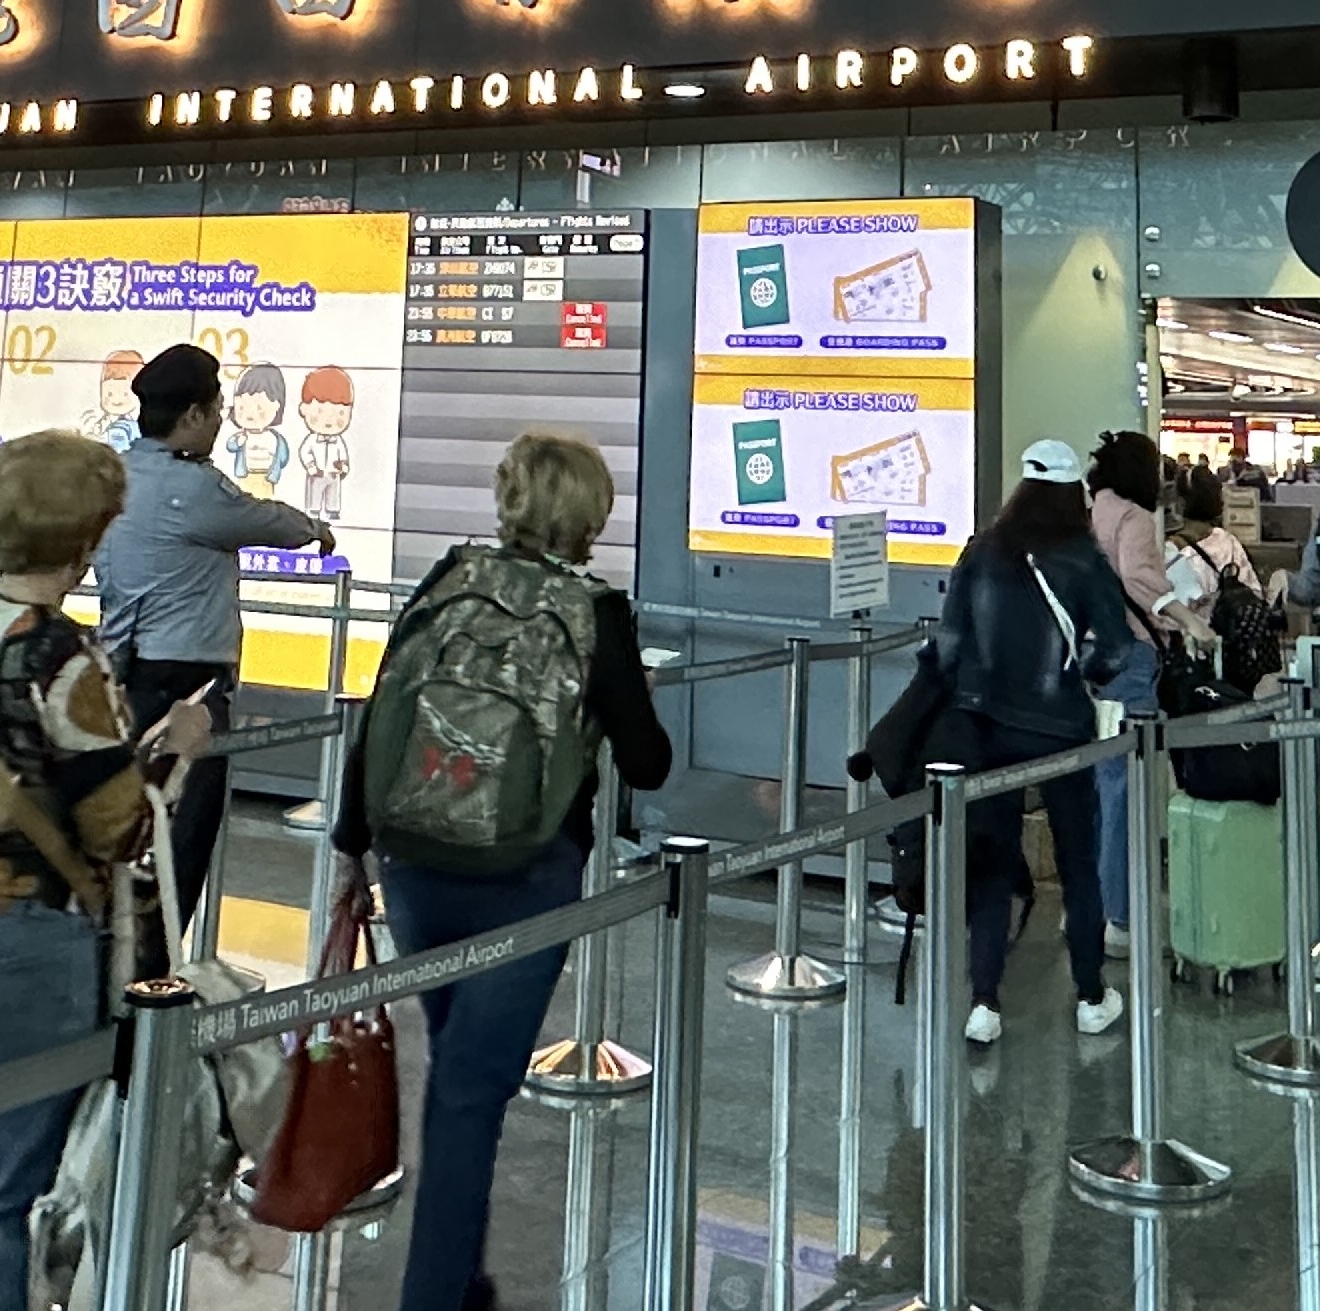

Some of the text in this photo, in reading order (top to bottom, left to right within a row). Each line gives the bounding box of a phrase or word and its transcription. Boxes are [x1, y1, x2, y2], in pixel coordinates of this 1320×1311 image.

[148, 64, 644, 128] INTERNATIONAL
[746, 35, 1092, 94] AIRPORT
[749, 215, 918, 236] 請出示 PLEASE SHOW
[133, 266, 254, 285] Three Steps for
[130, 288, 311, 310] a Swift Security Check
[8, 325, 56, 375] 02
[744, 390, 919, 411] 請出示 PLEASE SHOW
[241, 996, 299, 1030] Taiwan
[304, 980, 371, 1016] Taoyuan
[373, 956, 463, 996] International
[466, 937, 514, 970] Airport
